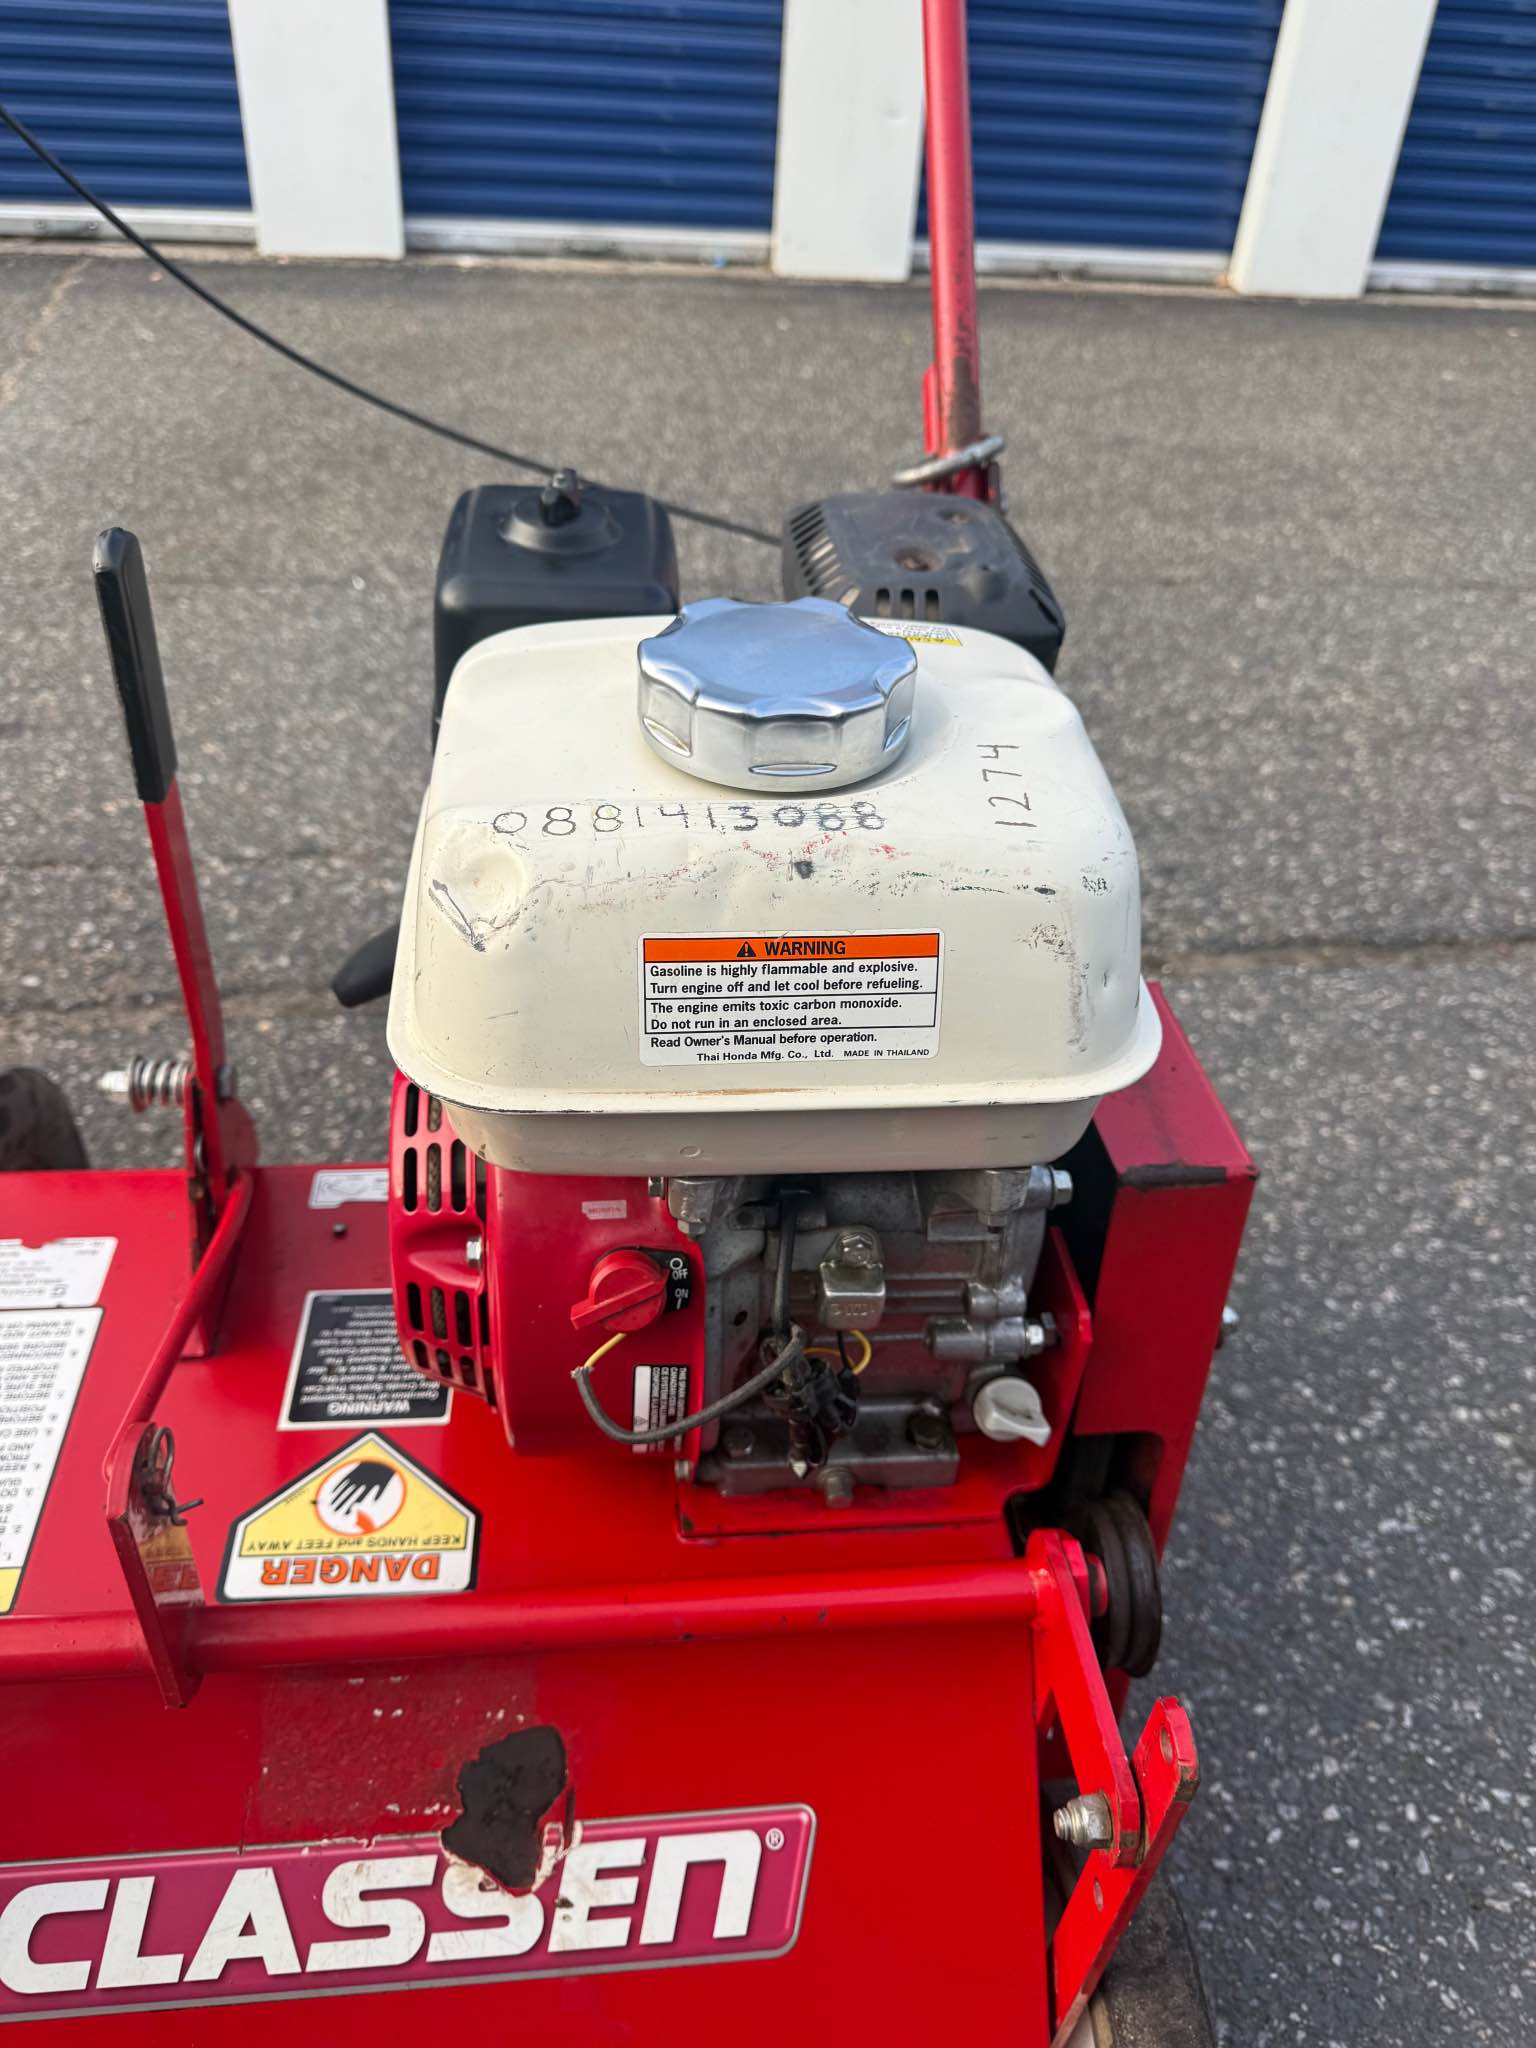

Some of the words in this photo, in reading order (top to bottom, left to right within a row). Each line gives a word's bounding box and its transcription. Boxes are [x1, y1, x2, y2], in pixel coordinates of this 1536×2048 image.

[977, 743, 1037, 829] 1274
[765, 941, 846, 956] WARNING
[650, 965, 702, 977] Gasoline
[707, 964, 716, 976] is
[720, 963, 757, 978] highly
[762, 962, 828, 974] flammable
[832, 962, 854, 974] and
[859, 961, 918, 974] explosive.
[650, 982, 677, 994] Turn
[682, 982, 722, 995] engine
[727, 981, 744, 992] off
[748, 981, 770, 992] and
[775, 980, 790, 991] let
[794, 980, 819, 990] cool
[824, 979, 862, 990] before
[867, 978, 922, 990] refueling.
[652, 1002, 673, 1014] The
[678, 1002, 718, 1014] engine
[722, 1000, 756, 1012] emits
[760, 999, 789, 1010] toxic
[794, 999, 836, 1010] carbon
[840, 997, 902, 1008] monoxide.
[651, 1018, 667, 1030] Do
[671, 1019, 690, 1029] not
[695, 1018, 715, 1028] run
[719, 1017, 729, 1028] in
[734, 1018, 748, 1028] an
[753, 1016, 807, 1027] enclosed
[811, 1016, 841, 1026] area.
[651, 1036, 680, 1047] Read
[684, 1036, 730, 1046] Owner's
[734, 1034, 776, 1045] Manual
[780, 1033, 816, 1044] before
[820, 1032, 877, 1044] operation.
[697, 1052, 719, 1062] Thai
[723, 1051, 757, 1060] Honda
[760, 1050, 783, 1060] Mfg.
[788, 1050, 808, 1060] Co.,
[814, 1049, 834, 1058] Ltd.
[887, 1048, 929, 1056] THAILAND
[672, 1268, 688, 1280] OFF
[675, 1288, 688, 1298] ON
[326, 1400, 410, 1416] WARNING
[246, 1540, 292, 1553] AWAY
[296, 1538, 333, 1550] FEET
[338, 1538, 364, 1549] and
[368, 1536, 418, 1548] HANDS
[423, 1533, 460, 1547] KEEP
[260, 1554, 440, 1586] DANGER
